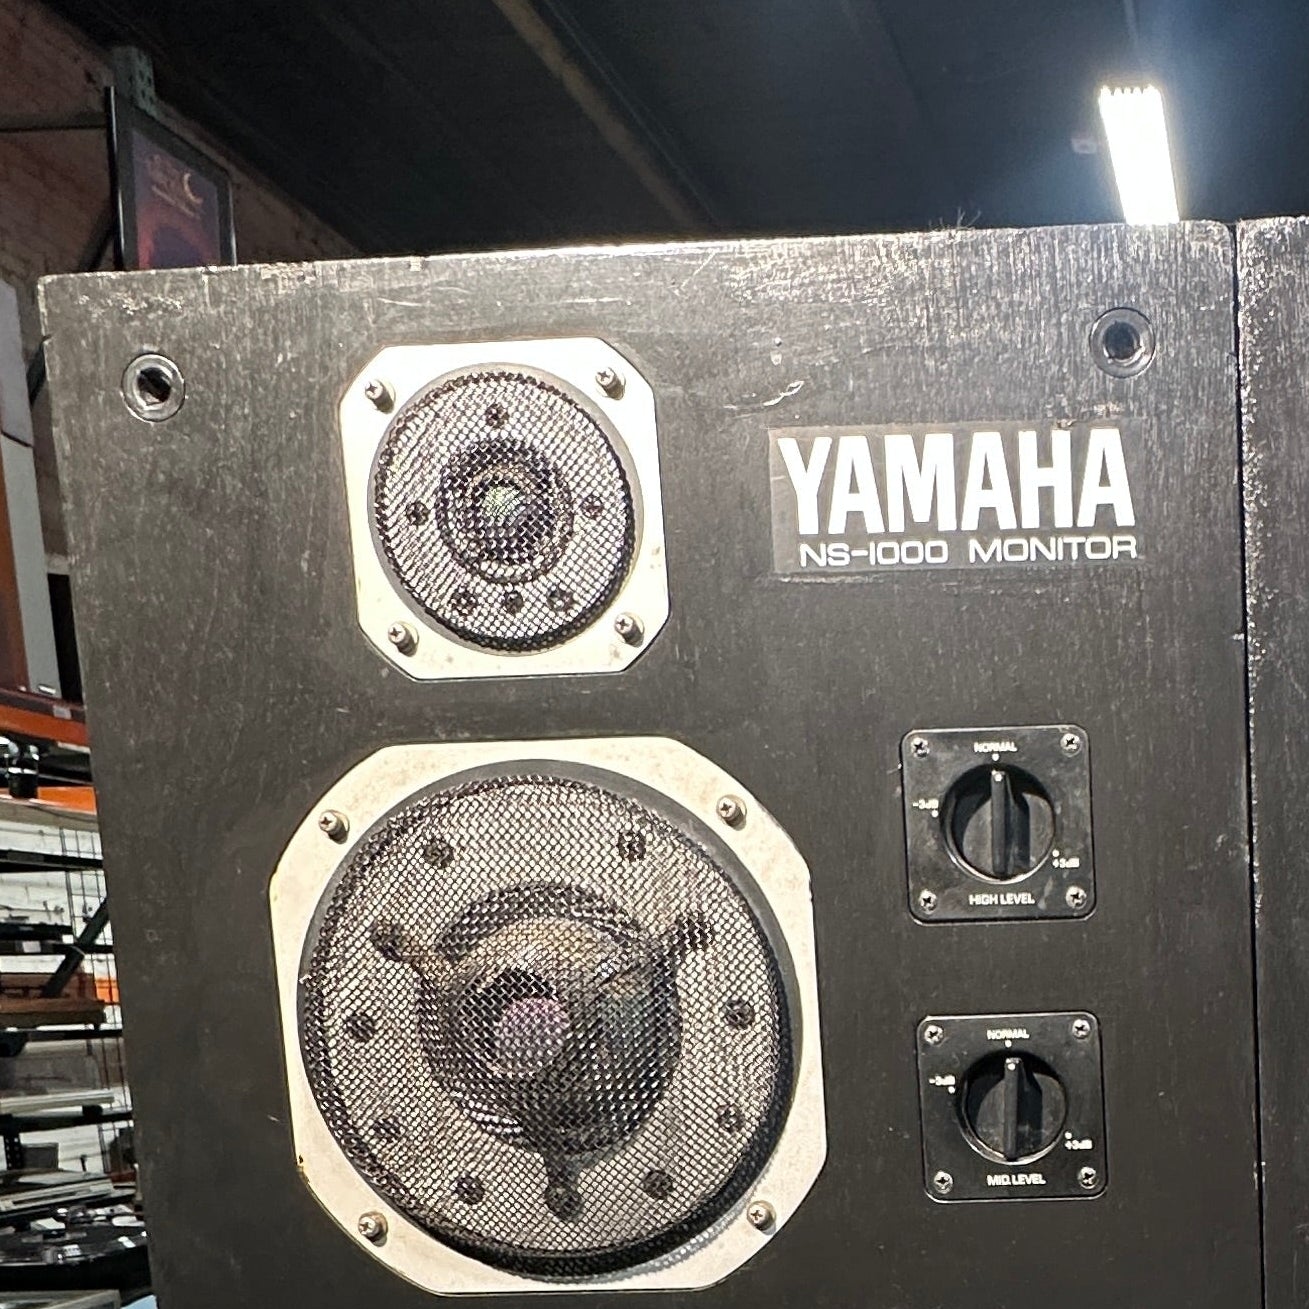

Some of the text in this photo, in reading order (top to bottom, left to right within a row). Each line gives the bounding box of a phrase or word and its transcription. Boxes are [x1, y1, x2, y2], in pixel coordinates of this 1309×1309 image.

[777, 428, 1136, 535] YAMAHA
[800, 535, 1138, 567] NS-1000 MONITOR
[974, 741, 1018, 752] NORMAL
[969, 892, 1035, 905] HIGH LEVEL
[987, 1029, 1030, 1040] NORMAL
[1012, 1173, 1046, 1185] LEVEL
